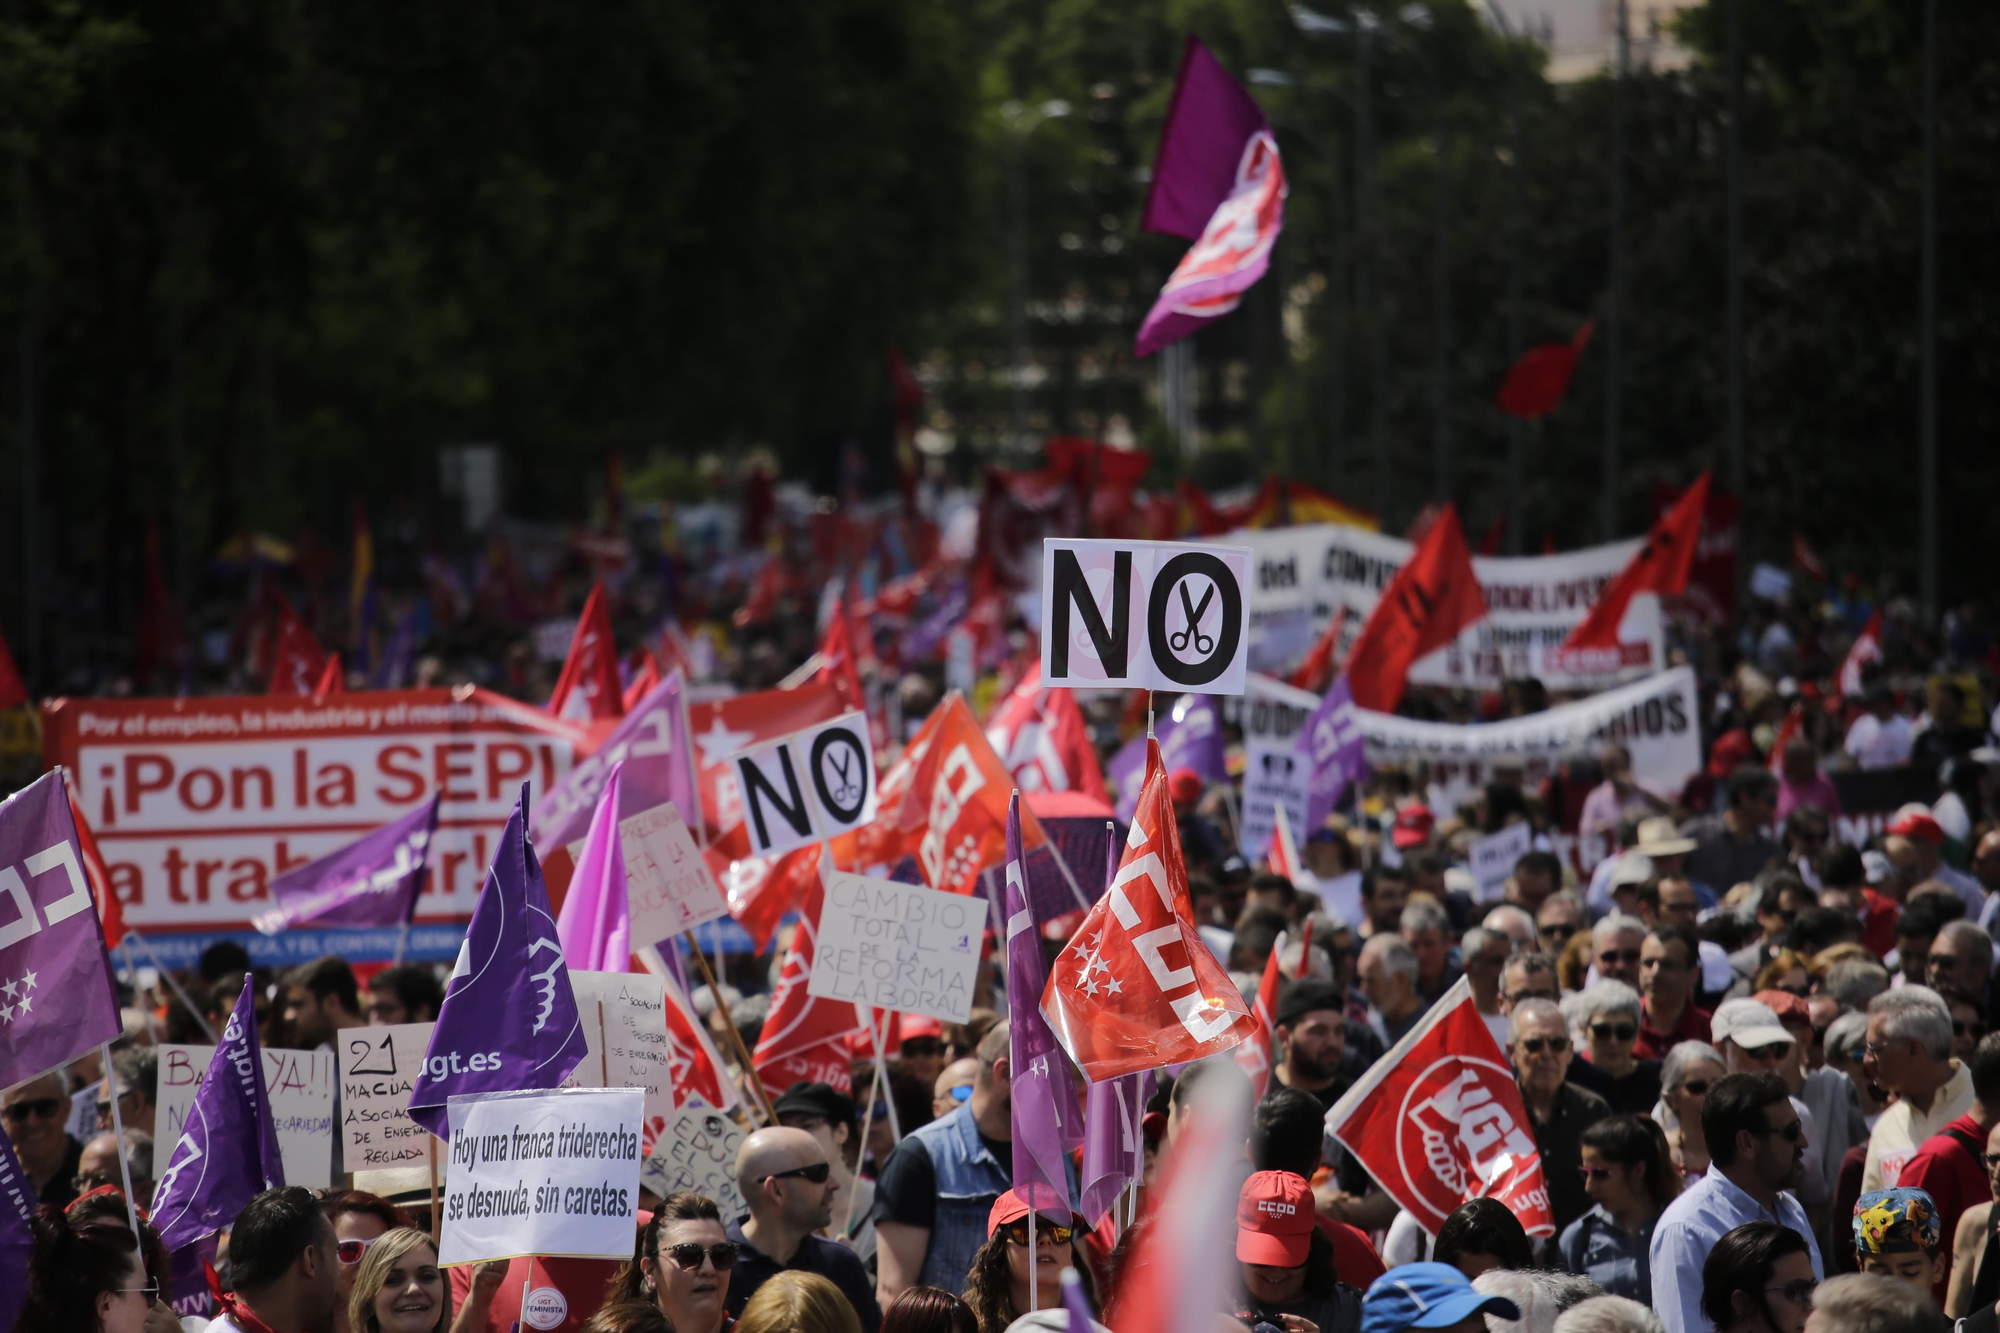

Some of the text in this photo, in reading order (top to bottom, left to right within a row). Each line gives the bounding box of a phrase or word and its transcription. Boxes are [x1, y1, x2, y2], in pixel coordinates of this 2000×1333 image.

[1050, 549, 1242, 686] NO
[79, 712, 120, 737] Por
[123, 712, 147, 736] el
[151, 708, 239, 738] empleo,
[242, 708, 264, 732] la
[267, 704, 365, 732] industria
[367, 709, 381, 731] y
[384, 705, 405, 727] el
[100, 753, 274, 827] ¡Pon
[293, 747, 356, 810] la
[738, 727, 868, 849] NO
[107, 860, 144, 906] a
[831, 880, 965, 929] CAMBIO
[851, 914, 939, 952] TOTAL
[860, 942, 920, 965] DE LA
[816, 945, 967, 996] REFORMA
[832, 975, 966, 1018] LABORAL
[622, 1015, 636, 1027] DE
[349, 1033, 397, 1075] 21
[611, 1048, 624, 1057] DE
[353, 1131, 371, 1144] DE
[364, 1148, 424, 1166] REGLADA
[453, 1123, 637, 1173] Hoy una franca triderecha
[448, 1192, 464, 1221] se
[467, 1179, 531, 1221] desnuda,
[534, 1177, 560, 1214] sin
[564, 1180, 632, 1218] caretas.
[1258, 1200, 1296, 1216] CCOO
[527, 1305, 563, 1314] FEMINISTA
